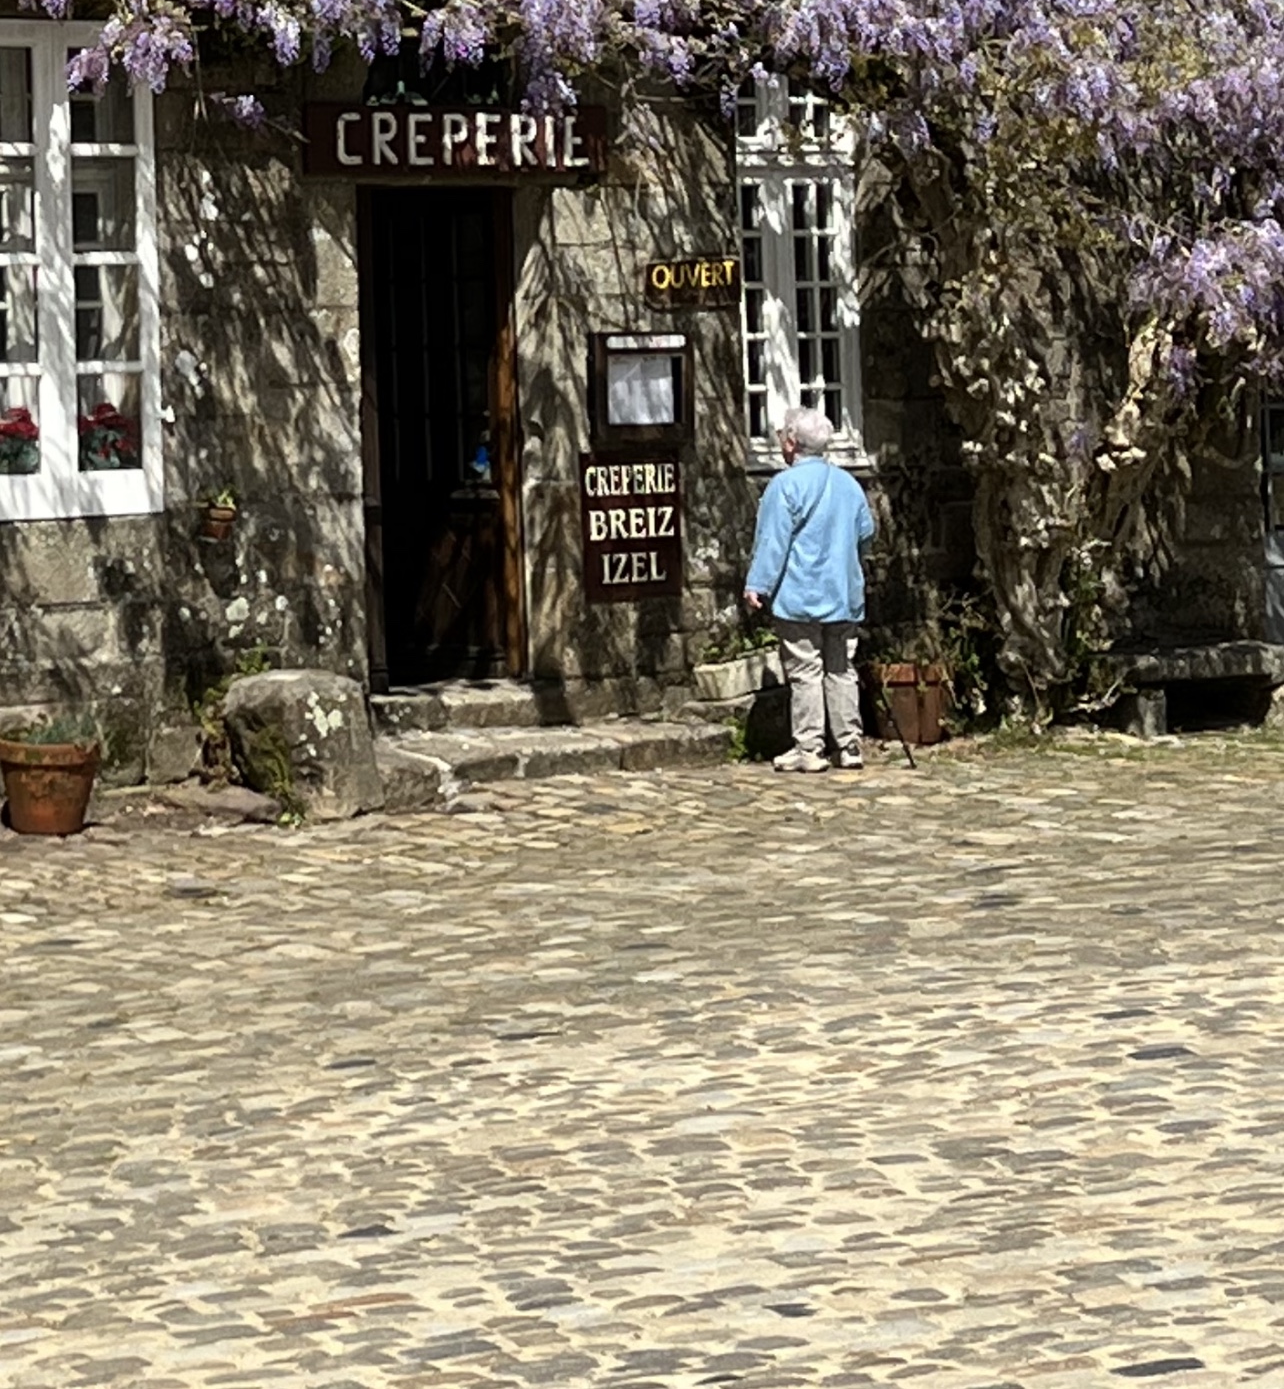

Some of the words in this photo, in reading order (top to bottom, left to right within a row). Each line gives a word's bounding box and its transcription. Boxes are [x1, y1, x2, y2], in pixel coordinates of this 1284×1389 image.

[337, 112, 589, 167] CREPERIE
[652, 260, 735, 289] OUVERT
[585, 463, 676, 496] CREPERIE
[589, 507, 675, 541] BREIZ
[601, 552, 667, 584] IZEL
